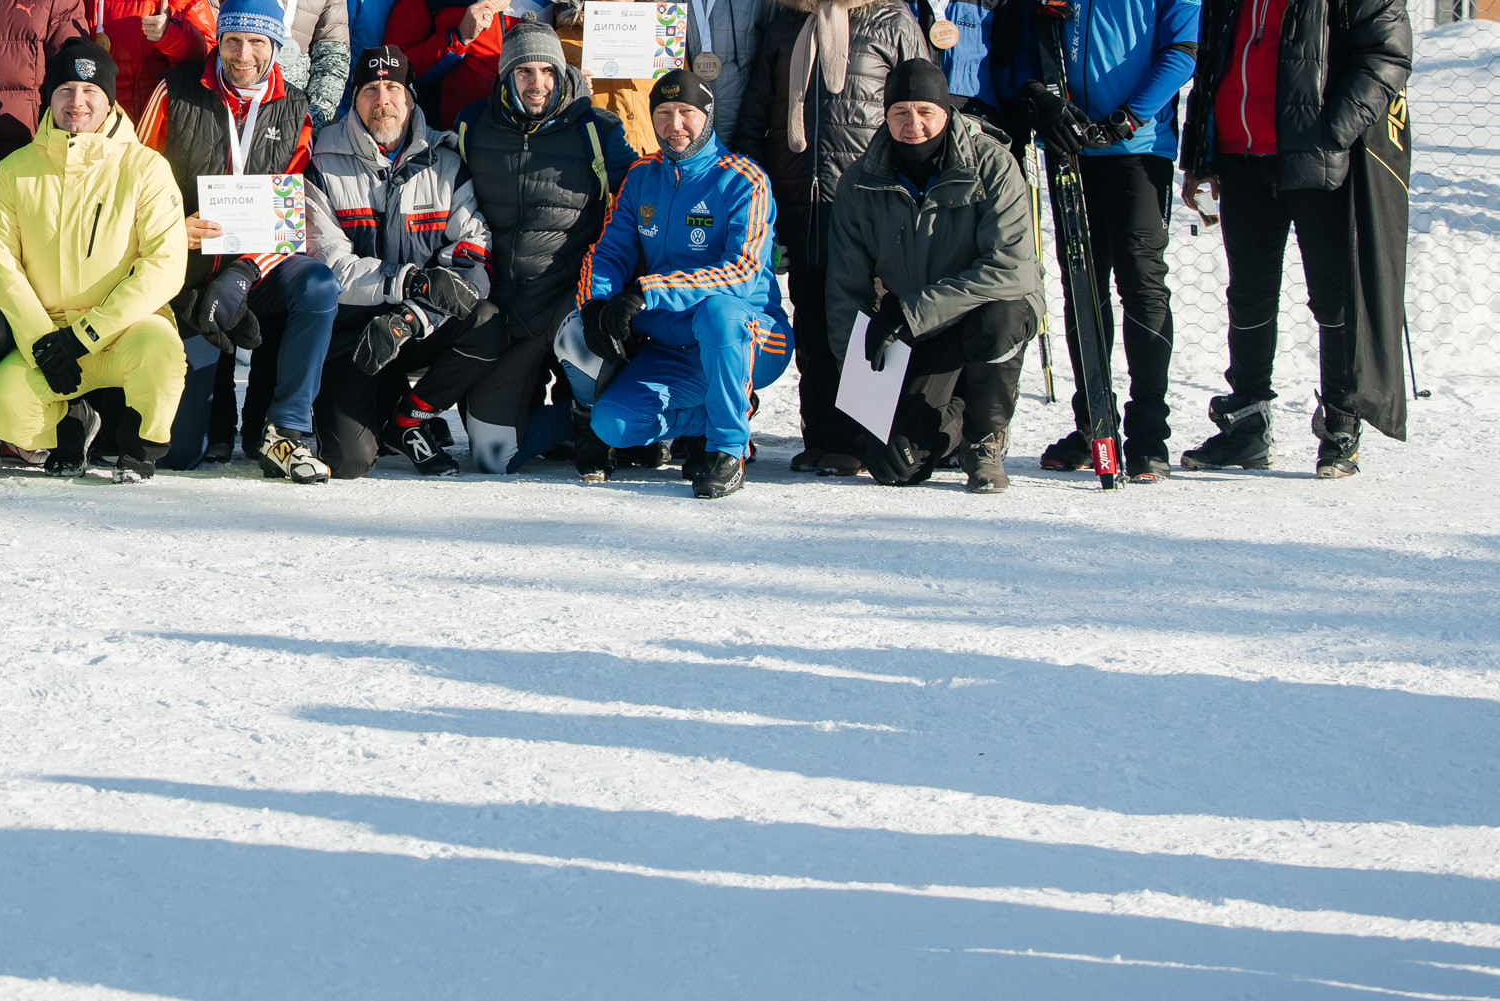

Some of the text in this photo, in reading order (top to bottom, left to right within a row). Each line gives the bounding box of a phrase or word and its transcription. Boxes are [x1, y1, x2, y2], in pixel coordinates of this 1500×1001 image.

[593, 23, 637, 32] ДИПЛОМ
[957, 20, 976, 29] adidas
[368, 54, 399, 69] DNB
[208, 197, 254, 206] ДИПЛОМ
[208, 303, 217, 322] CRAFT
[1097, 442, 1112, 470] swix
